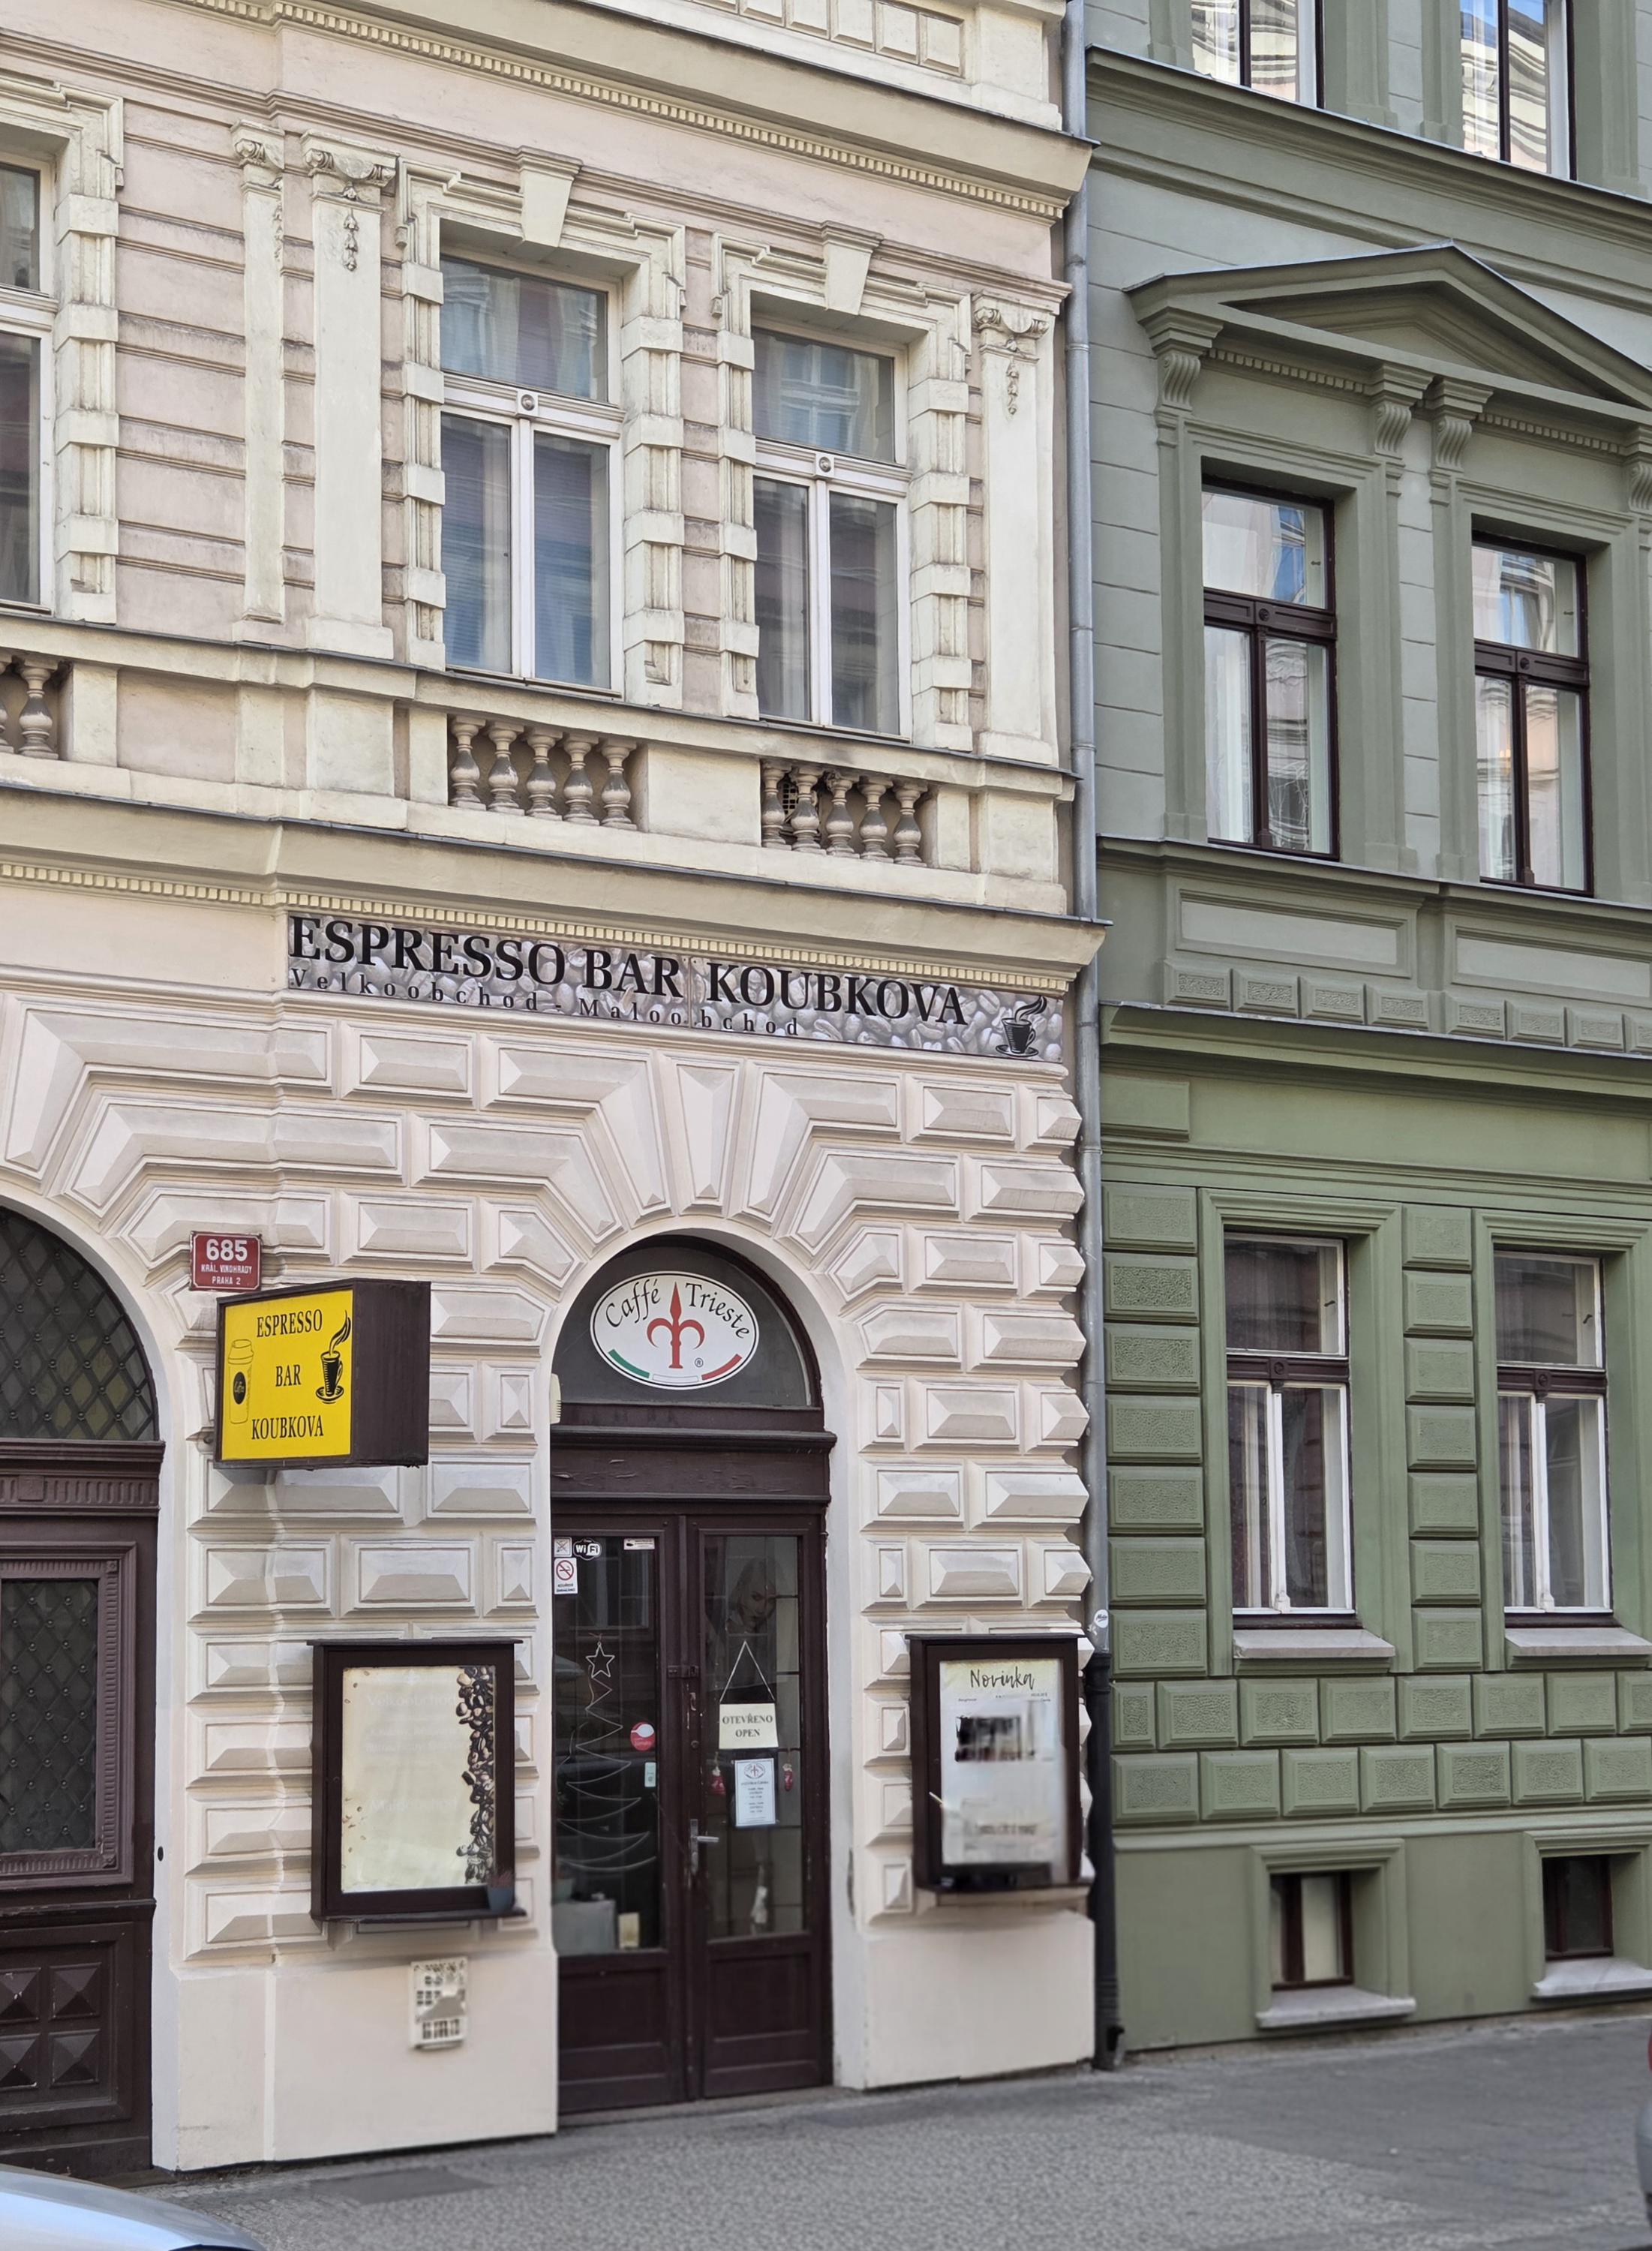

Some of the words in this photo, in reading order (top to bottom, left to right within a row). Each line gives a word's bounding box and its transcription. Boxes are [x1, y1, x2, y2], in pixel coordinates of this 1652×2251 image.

[290, 916, 566, 985] ESPRESSO
[582, 948, 684, 998] BAR
[706, 962, 969, 1026] KOUBKOVA
[291, 968, 538, 1011] Velkoobchod
[578, 998, 797, 1036] Maloobchod
[206, 1239, 248, 1261] 685
[212, 1276, 233, 1285] PRAHA
[236, 1277, 241, 1285] 2
[220, 1264, 252, 1275] VINOHRADY
[685, 1282, 749, 1339] Trieste
[256, 1309, 323, 1338] ESPRESSO
[275, 1364, 302, 1387] BAR
[251, 1414, 324, 1441] KOUBKOVA
[970, 1666, 1035, 1690] Novinka
[722, 1712, 773, 1724] OTEVŘENO
[735, 1729, 761, 1738] OPEN
